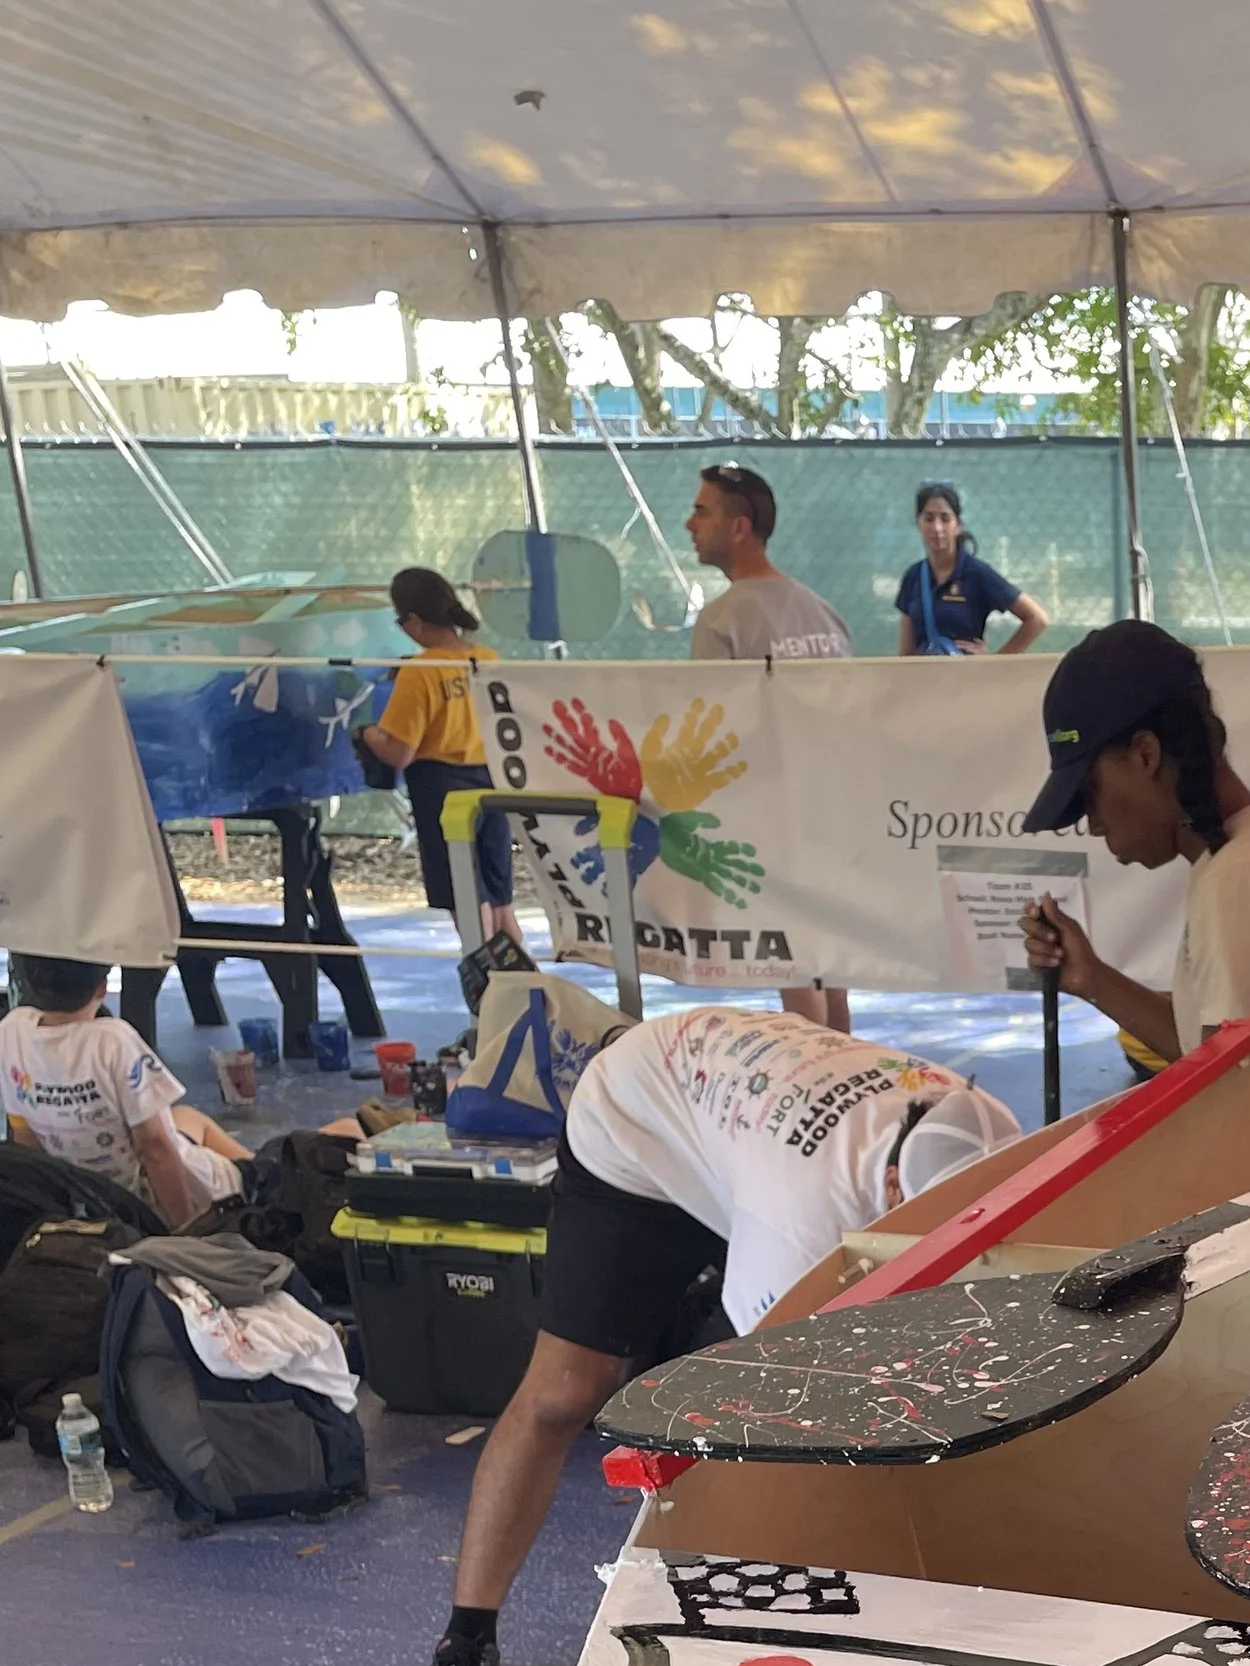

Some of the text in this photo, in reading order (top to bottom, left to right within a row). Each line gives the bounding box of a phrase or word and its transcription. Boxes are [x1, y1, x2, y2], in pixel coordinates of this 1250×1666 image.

[769, 631, 843, 658] MENTOR
[785, 1067, 883, 1148] REGATTA
[800, 1076, 895, 1158] PLYWOOD
[445, 1272, 495, 1293] RYOBI
